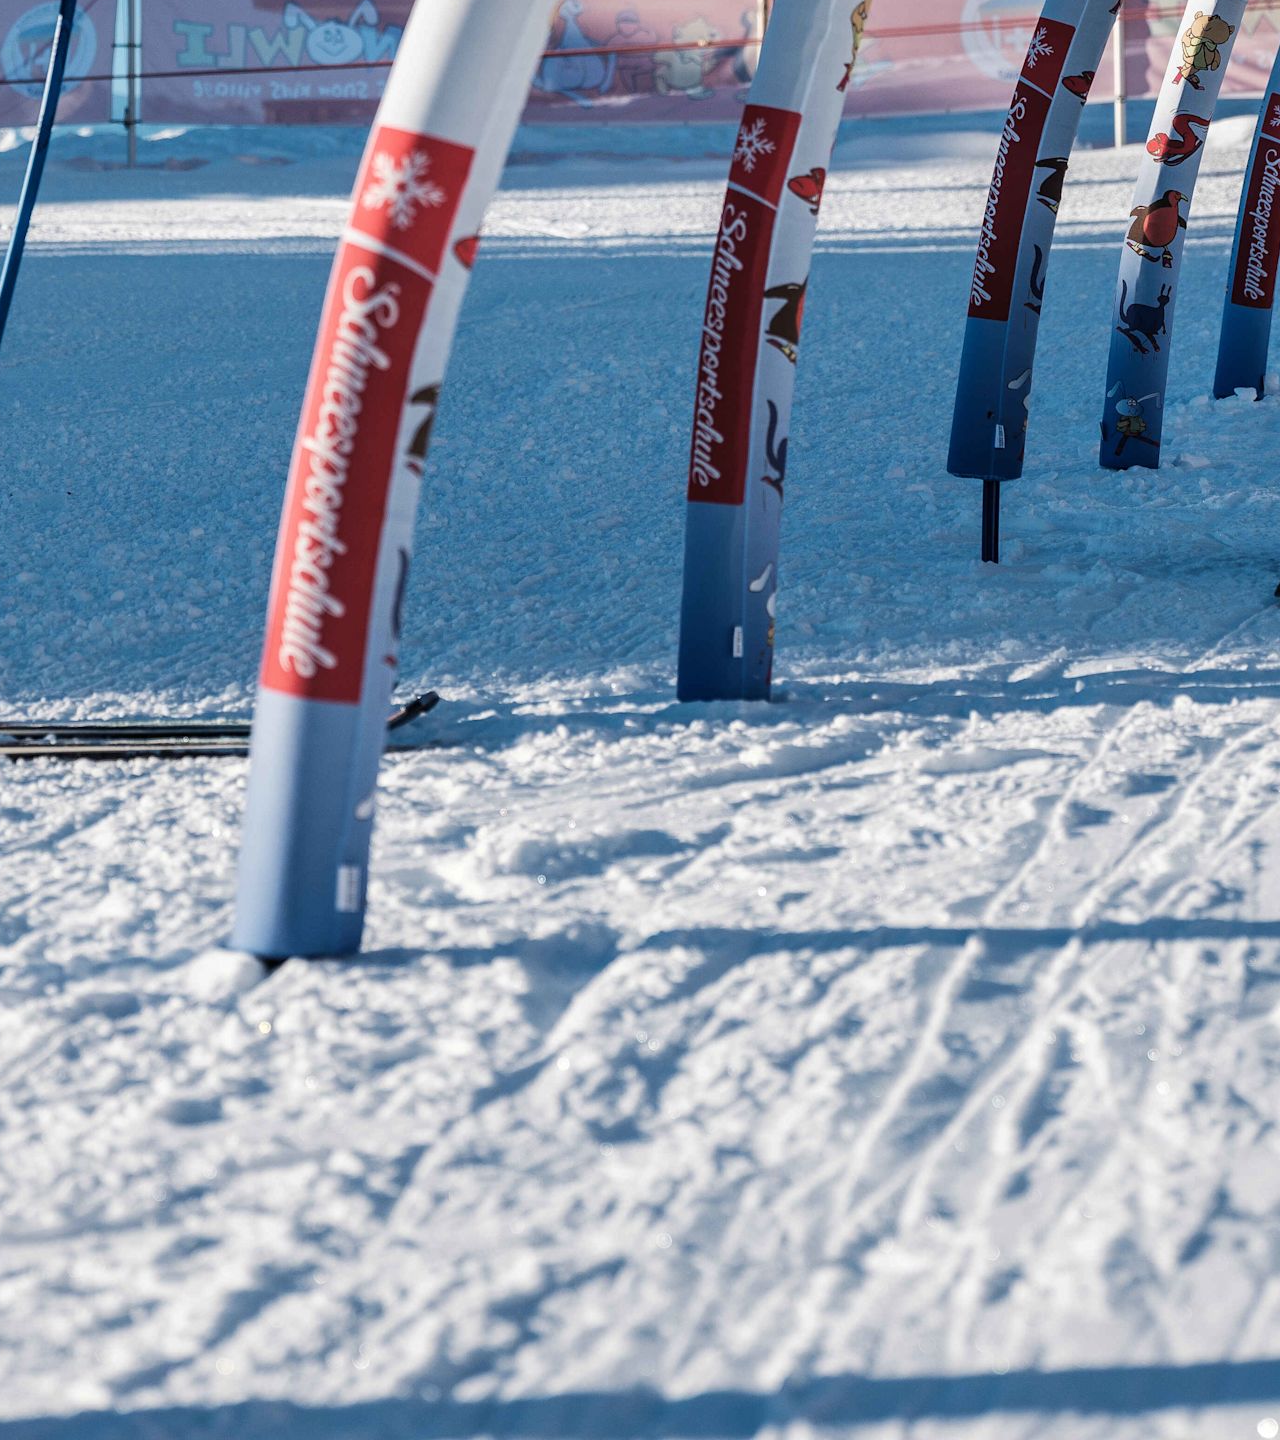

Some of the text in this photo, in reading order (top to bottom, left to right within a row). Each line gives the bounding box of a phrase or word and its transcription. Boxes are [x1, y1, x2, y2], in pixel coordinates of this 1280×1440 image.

[970, 90, 1027, 308] Schneesportschule
[277, 263, 401, 680] Schneesportschule
[692, 202, 748, 488] Schneesportschule
